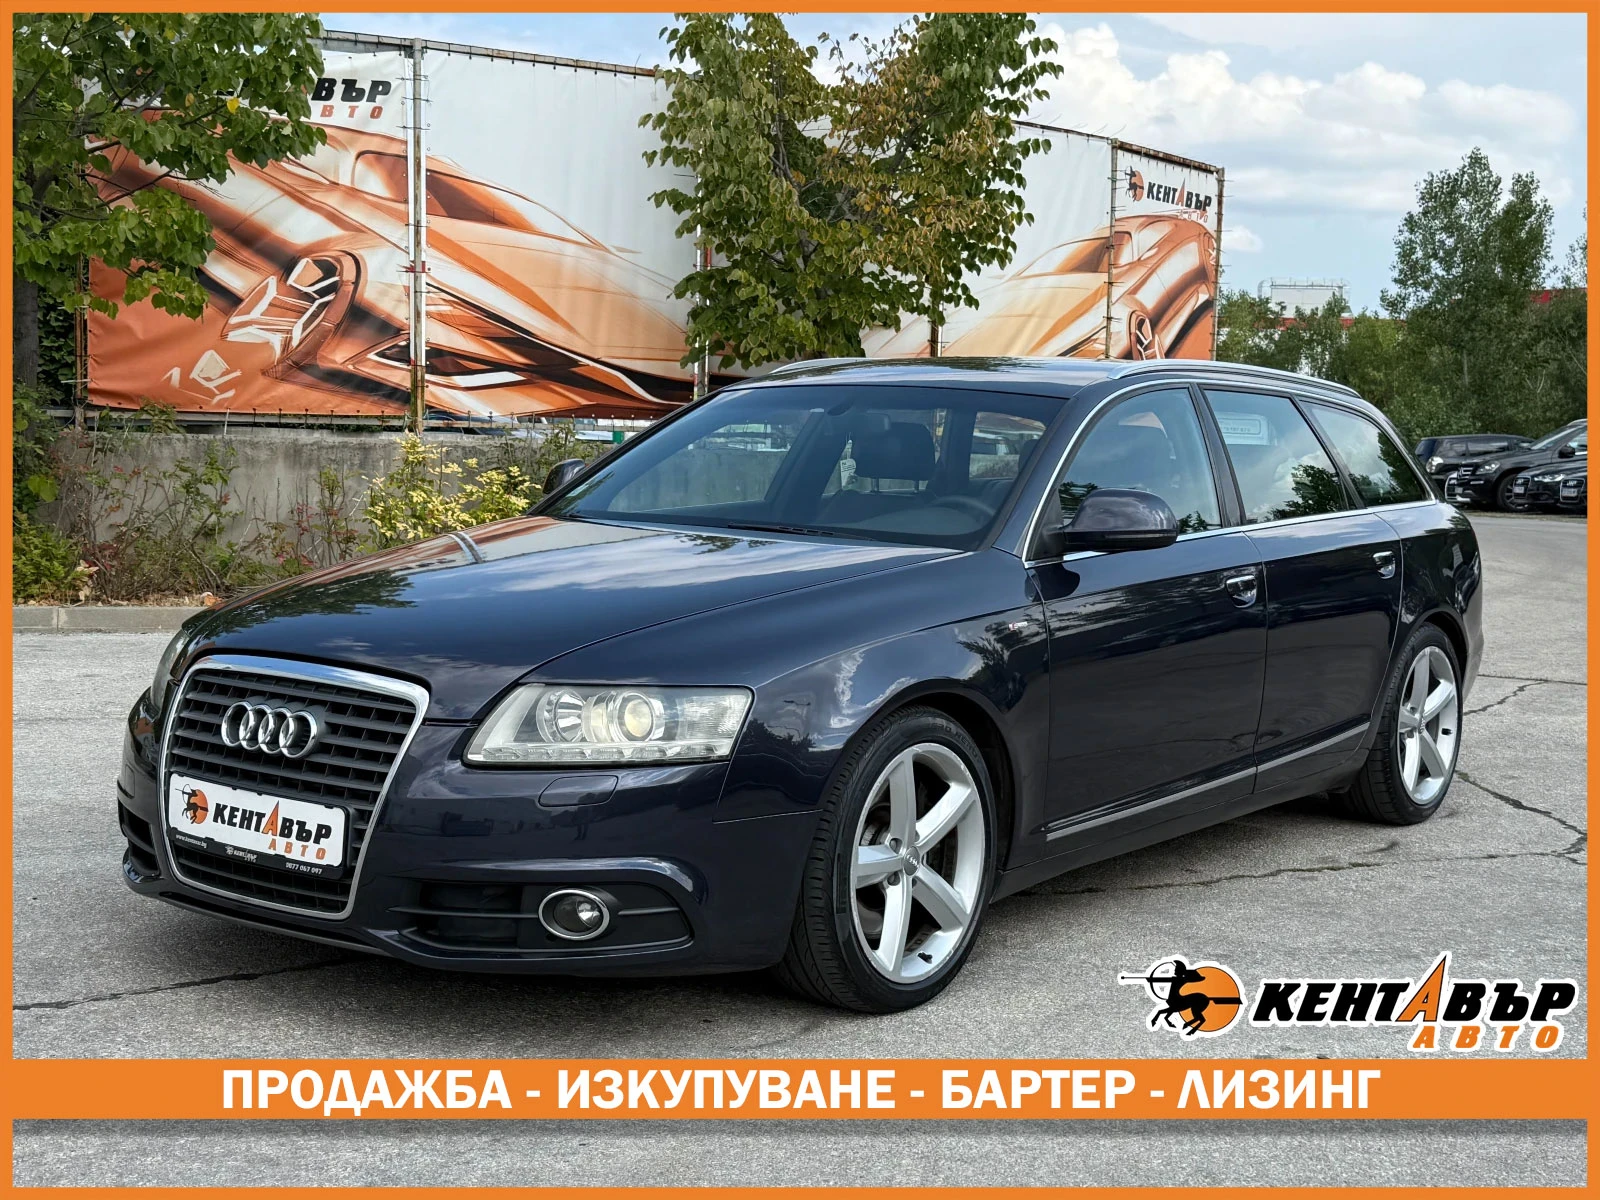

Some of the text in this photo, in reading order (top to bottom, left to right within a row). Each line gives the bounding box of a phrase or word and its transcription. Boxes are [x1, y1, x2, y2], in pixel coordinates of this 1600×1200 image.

[320, 104, 383, 119] ВТО
[1146, 177, 1213, 211] КЕНТАВЪР
[212, 800, 332, 845] КЕНТАВЪР
[268, 838, 327, 860] АВТО
